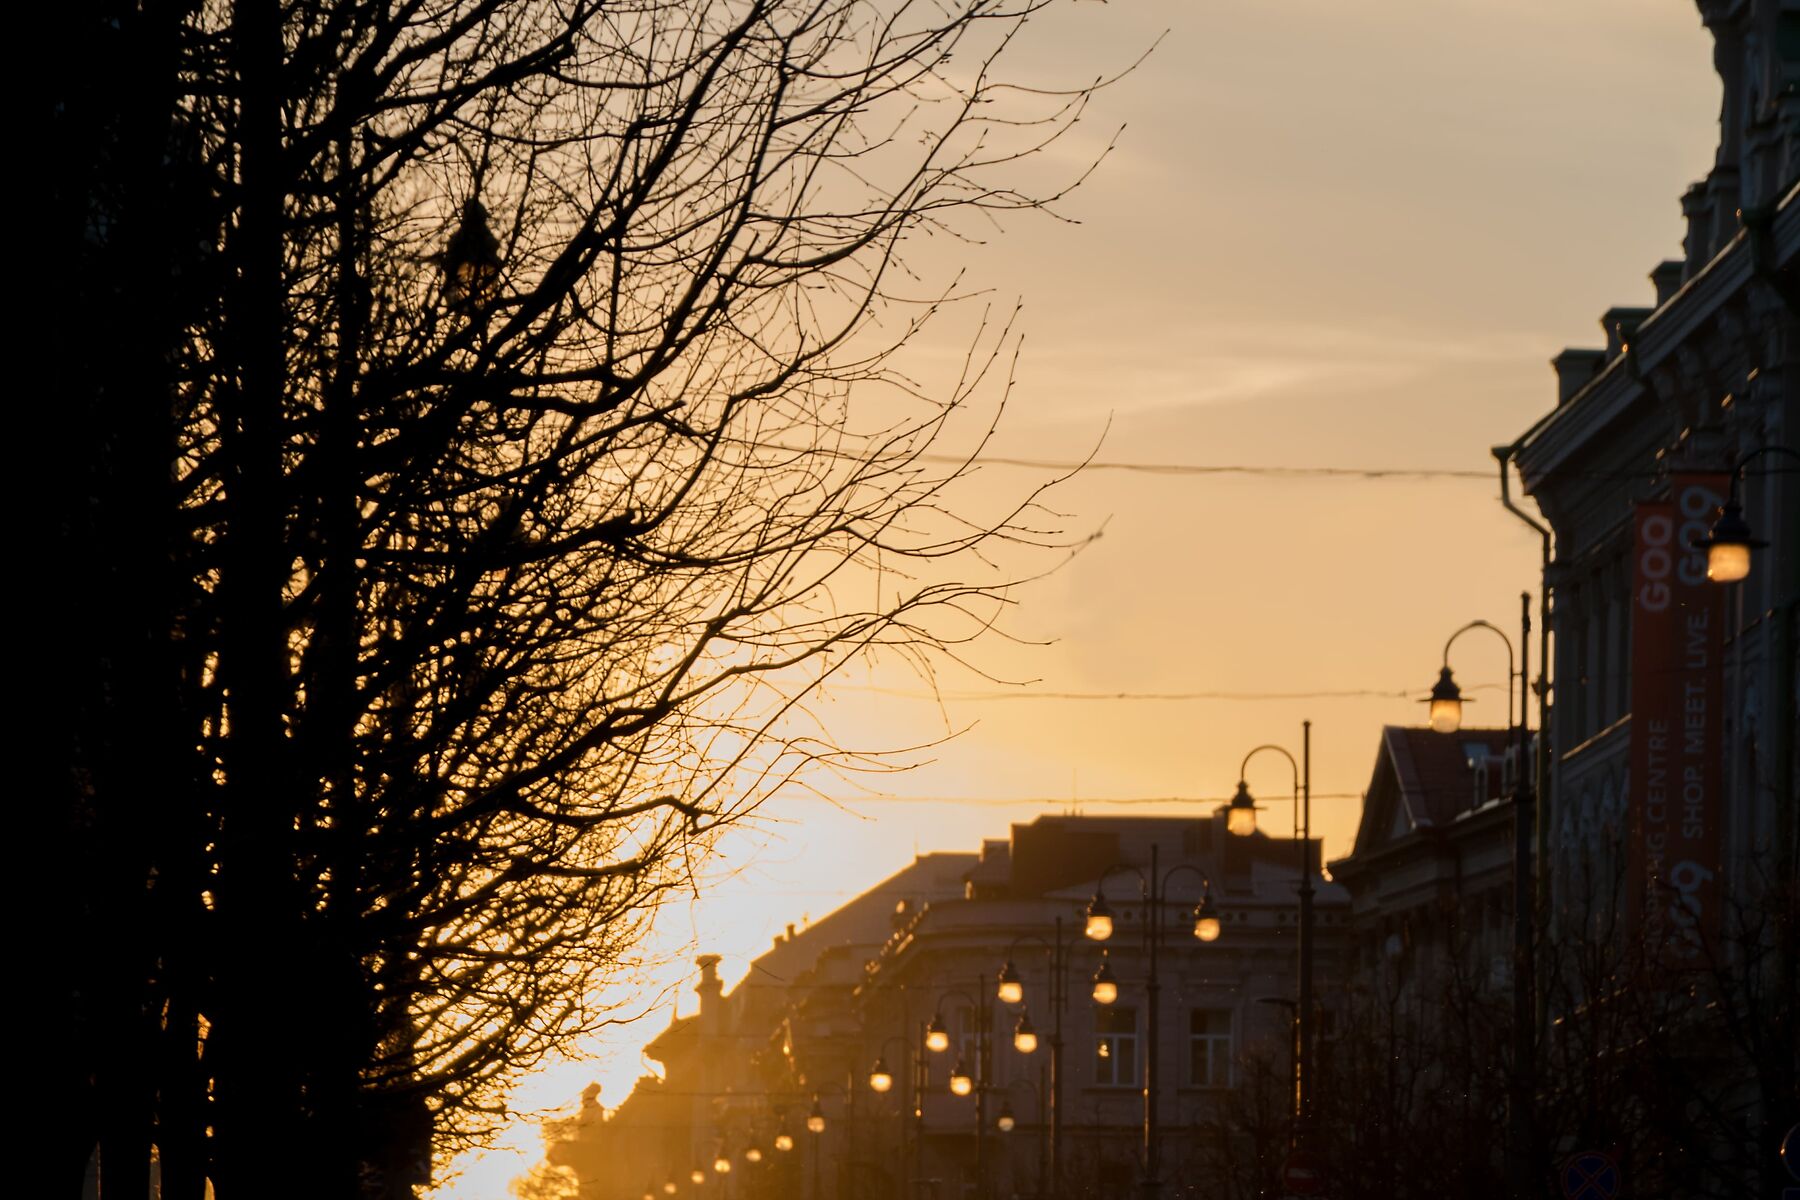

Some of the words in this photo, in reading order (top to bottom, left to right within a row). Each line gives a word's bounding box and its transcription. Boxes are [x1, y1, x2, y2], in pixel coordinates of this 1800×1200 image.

[1686, 607, 1710, 668] LIVE.
[1684, 677, 1706, 753] MEET.
[1647, 719, 1668, 823] CENTRE
[1682, 763, 1704, 839] SHOP.
